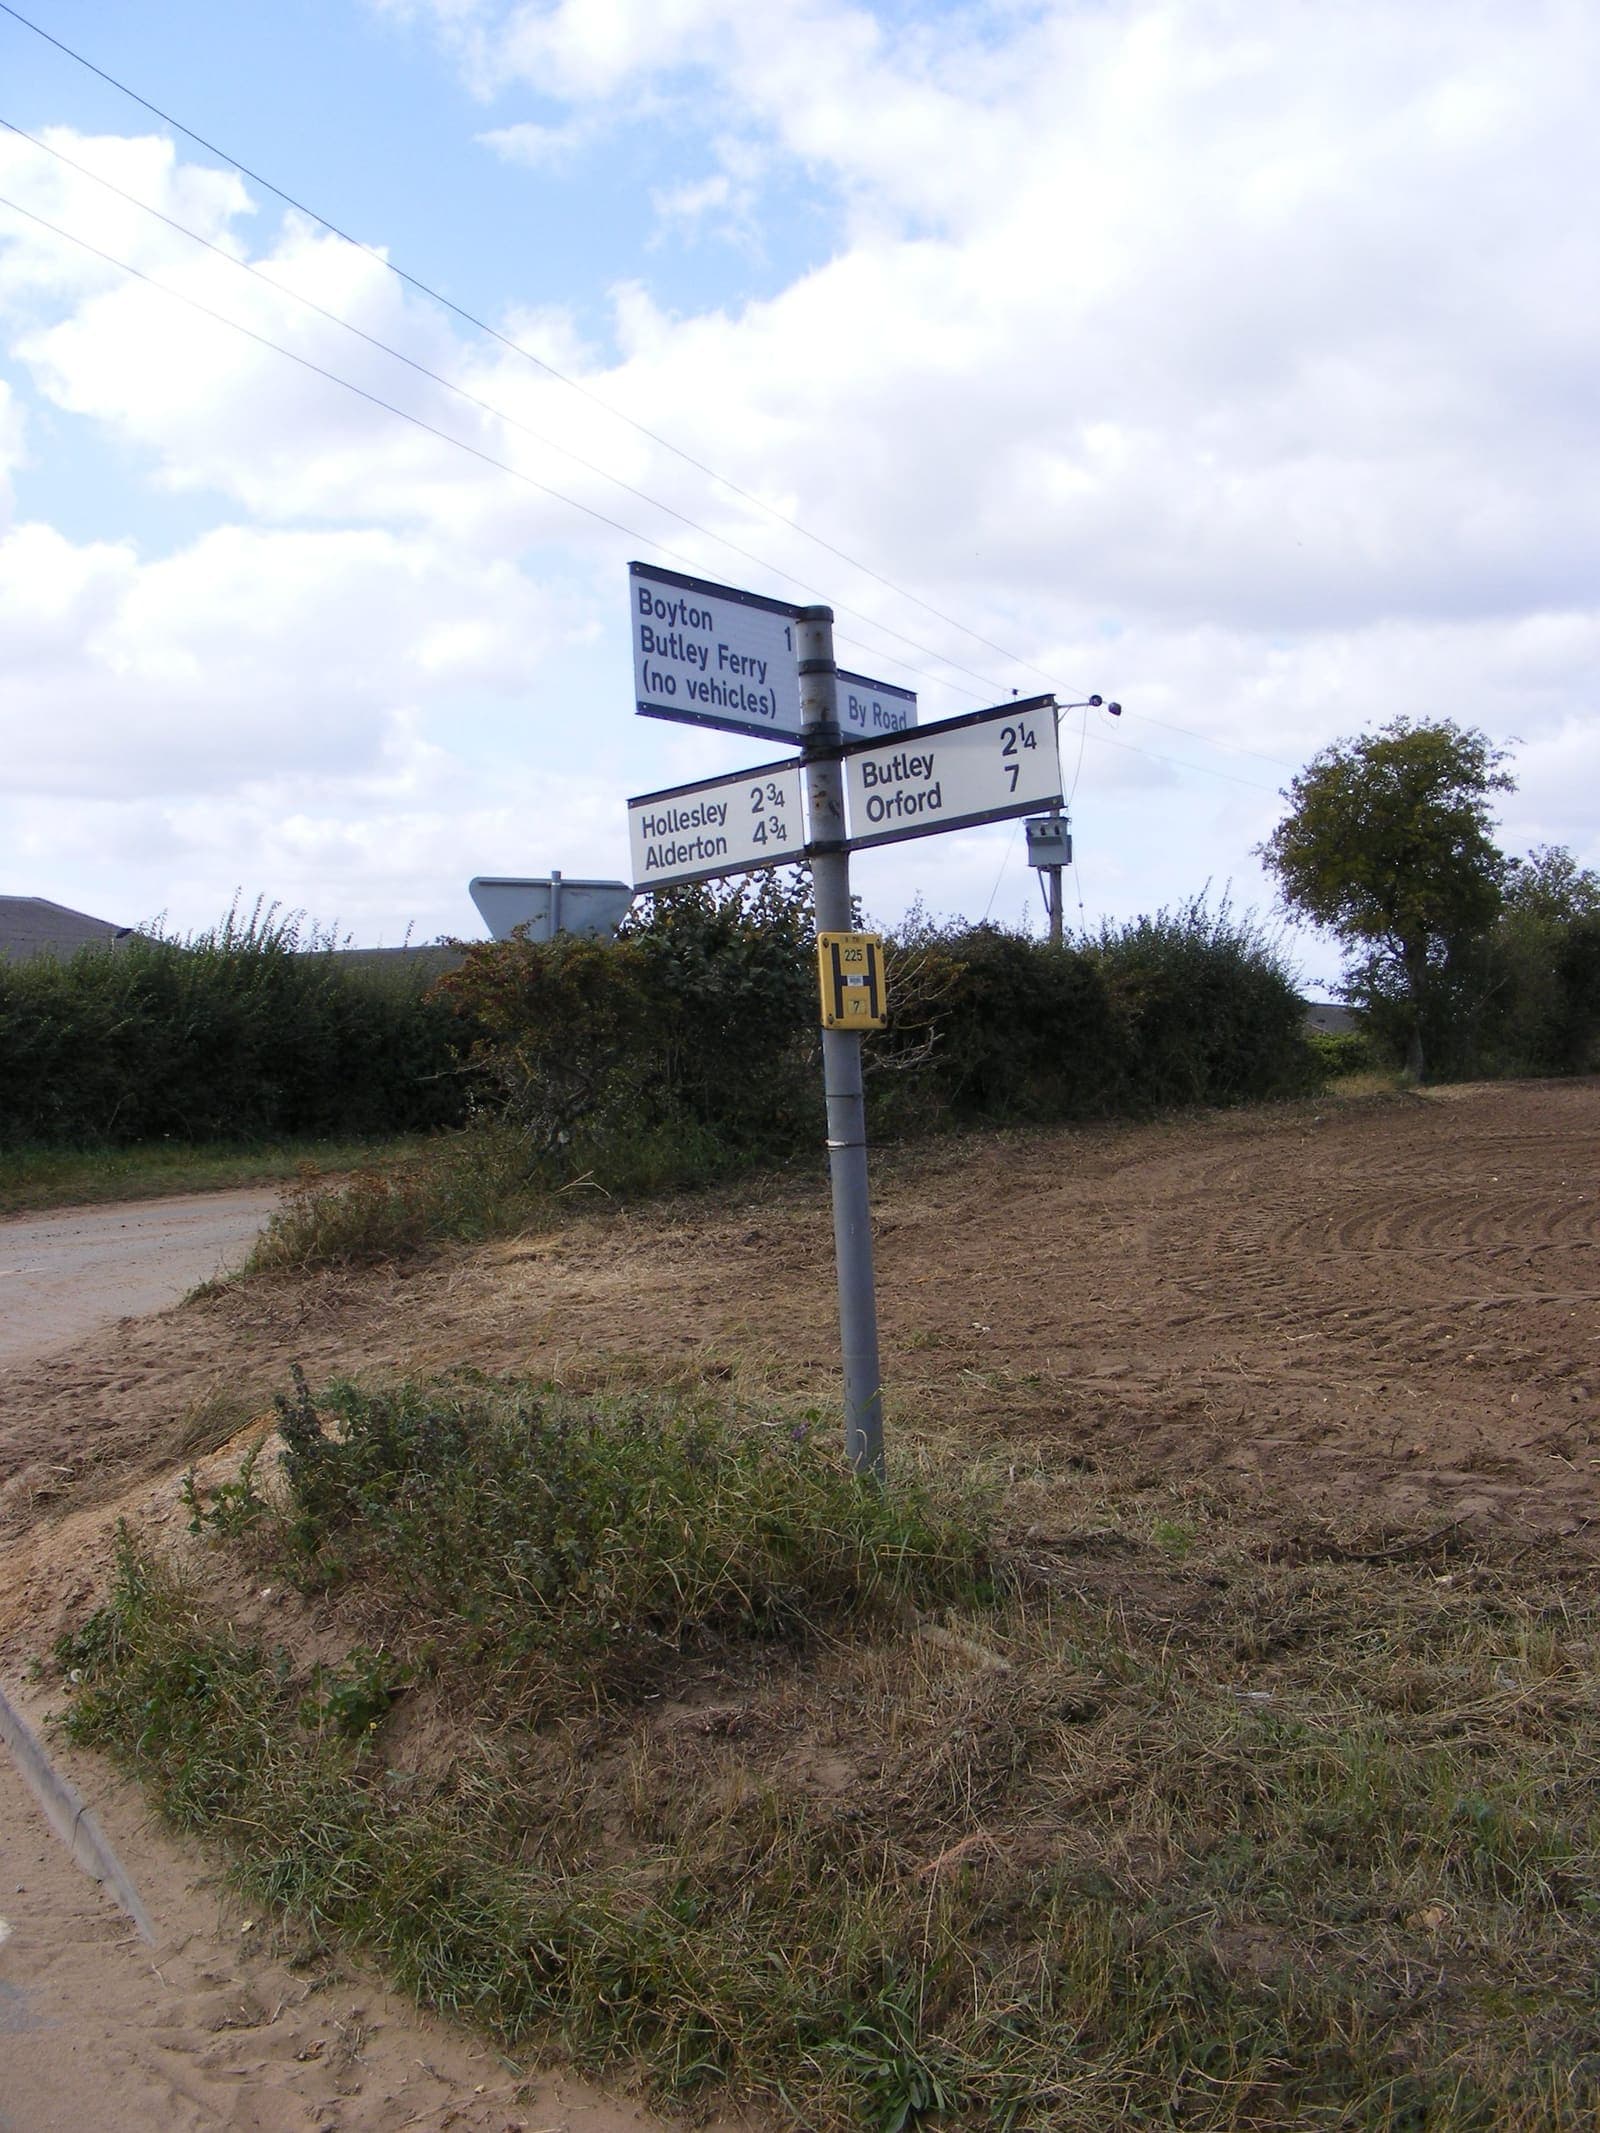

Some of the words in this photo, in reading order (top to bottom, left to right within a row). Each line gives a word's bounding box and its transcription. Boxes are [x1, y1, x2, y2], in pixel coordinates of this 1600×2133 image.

[638, 587, 713, 631] Boyton
[784, 626, 792, 651] 1
[640, 624, 709, 671] Butley
[718, 643, 767, 685] Ferry
[643, 659, 677, 695] (no
[686, 677, 776, 719] vehicles)
[848, 695, 867, 727] By
[872, 702, 907, 730] Road
[862, 752, 934, 788] Butley
[866, 782, 942, 822] Orford
[1004, 764, 1020, 792] 7
[642, 802, 728, 839] Hollesley
[645, 836, 727, 871] Alderton
[844, 949, 863, 962] 225
[853, 1000, 860, 1013] 7
